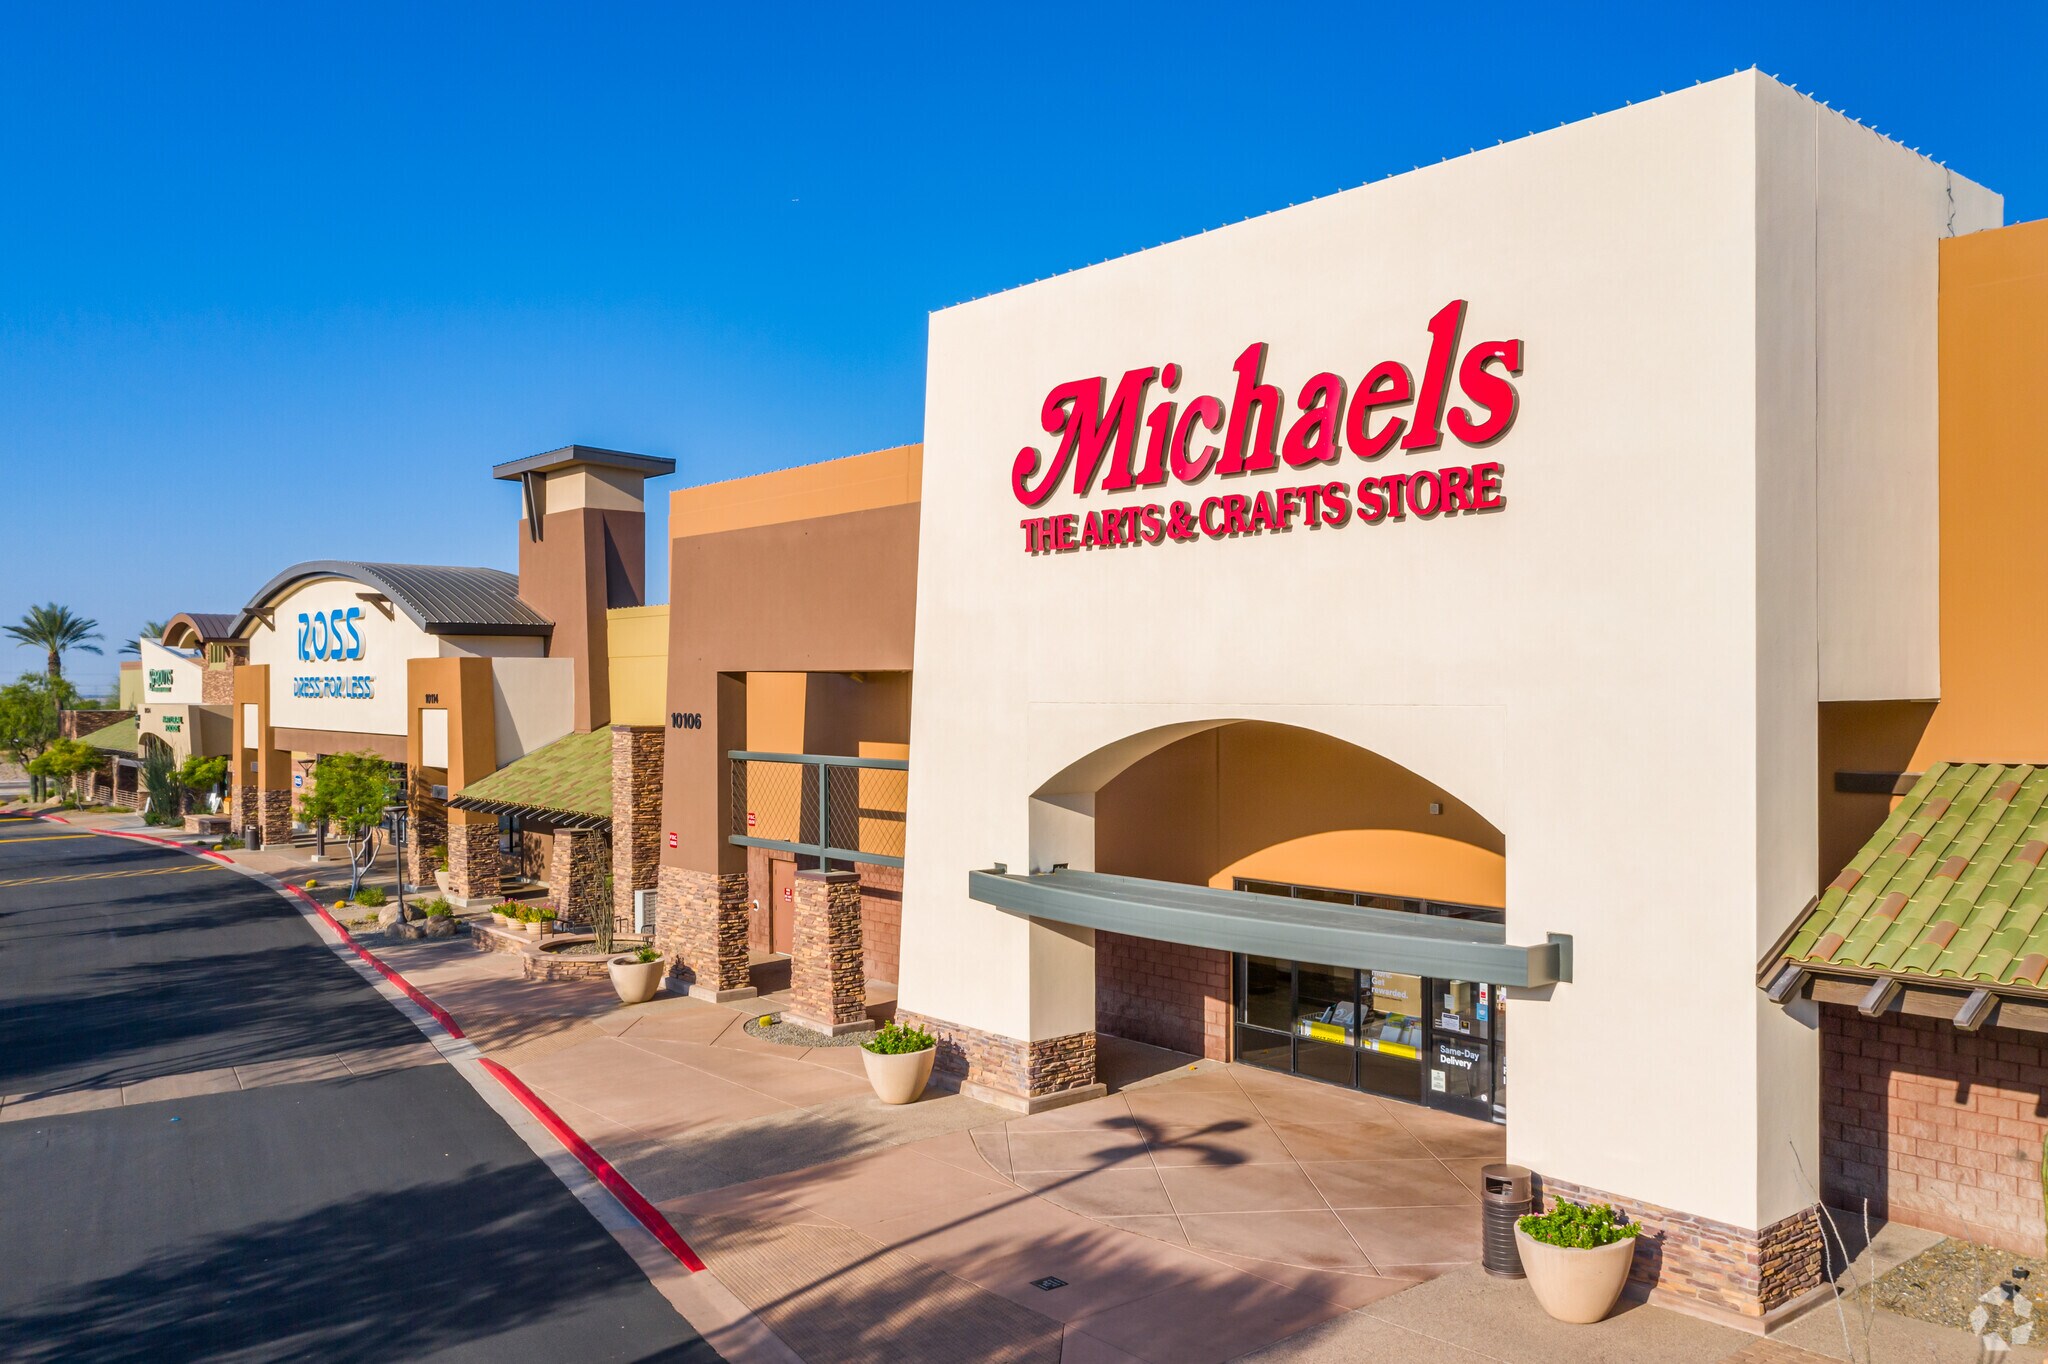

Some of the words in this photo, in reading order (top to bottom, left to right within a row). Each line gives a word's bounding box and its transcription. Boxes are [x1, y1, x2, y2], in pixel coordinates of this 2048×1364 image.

[1012, 299, 1521, 506] Michaels
[1020, 513, 1077, 554] THE
[1080, 503, 1163, 548] ARTS
[1166, 500, 1197, 540] &
[1199, 481, 1348, 537] CRAFTS
[1357, 461, 1503, 522] STORE
[298, 607, 364, 661] ROSS
[294, 676, 322, 698] DRESS
[324, 676, 345, 698] FOR
[346, 675, 374, 699] LESS
[671, 712, 702, 730] 10106
[1371, 976, 1386, 986] Get
[1371, 987, 1409, 999] rewarded.
[1440, 1045, 1480, 1061] Same-Day
[1440, 1055, 1472, 1070] Delivery
